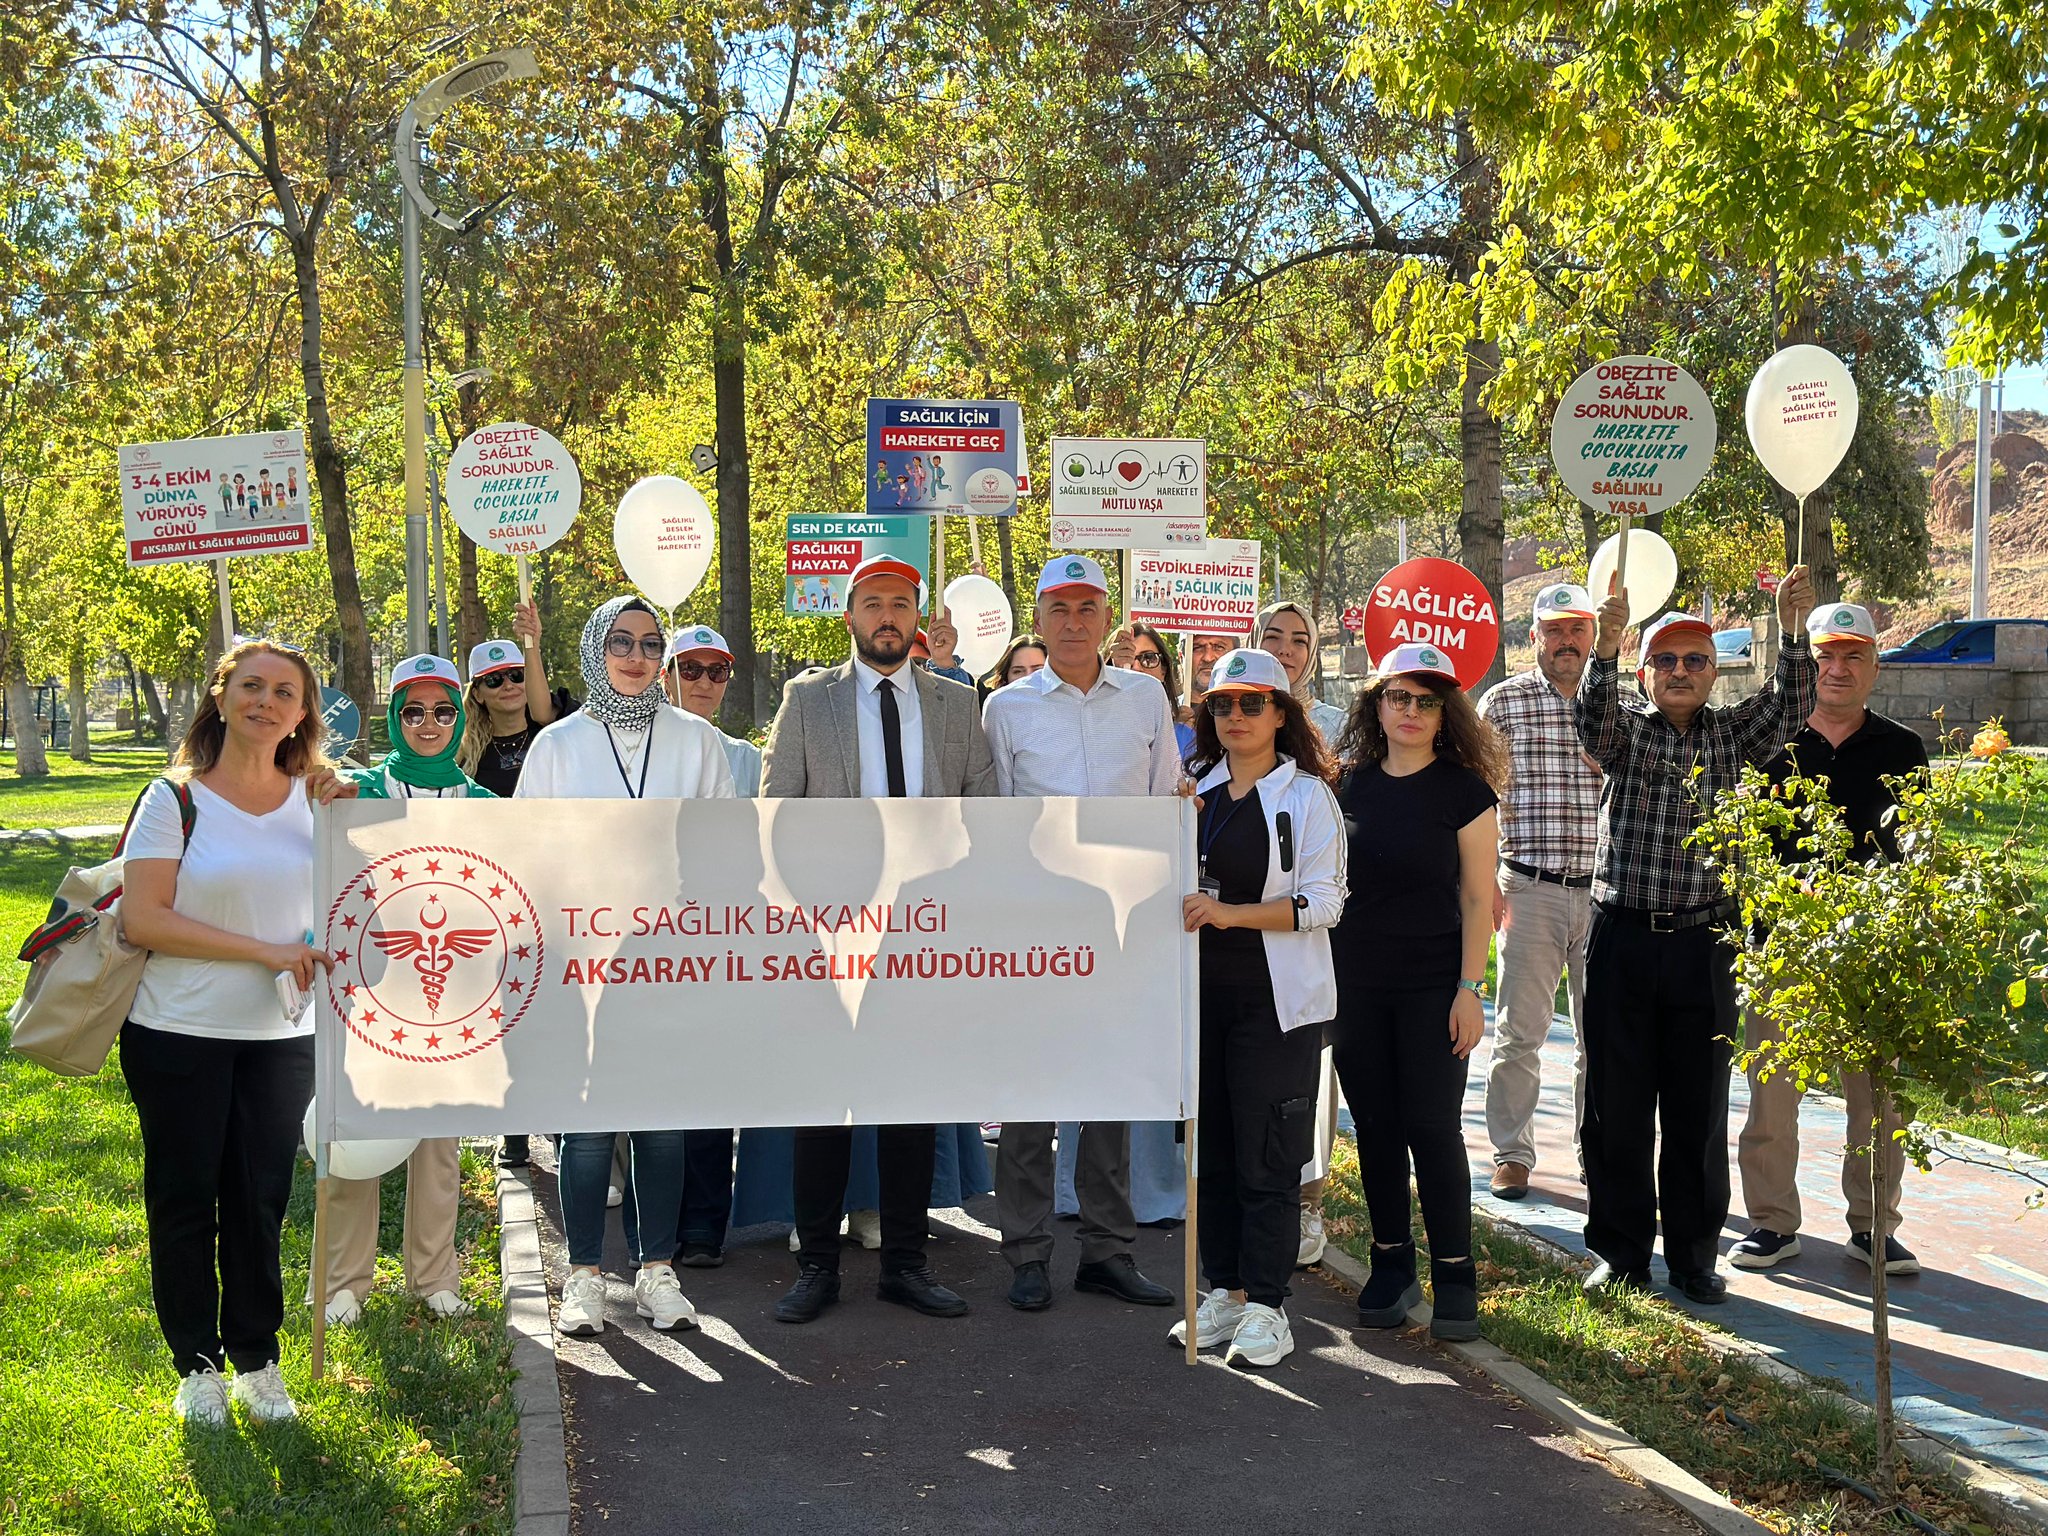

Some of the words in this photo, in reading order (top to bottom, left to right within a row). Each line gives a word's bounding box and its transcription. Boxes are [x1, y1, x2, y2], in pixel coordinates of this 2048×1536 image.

[1596, 364, 1678, 382] OBEZİTE
[1598, 381, 1666, 400] SAĞLIK
[1787, 380, 1828, 393] SAĞLIKLI
[1791, 391, 1825, 402] BESLEN
[1573, 403, 1694, 421] SORUNUDUR.
[1782, 402, 1816, 414] SAĞLIK
[1818, 400, 1837, 410] İÇİN
[899, 409, 955, 424] SAĞLIK
[958, 410, 990, 427] İÇİN
[1783, 411, 1825, 425] HAREKET
[1828, 410, 1838, 418] ET
[473, 428, 540, 446] OBEZİTE
[1592, 423, 1680, 441] HAREKETE
[885, 434, 966, 448] HAREKETE
[969, 435, 1000, 451] GEÇ
[1580, 442, 1689, 460] ÇOCUKLUKTA
[478, 444, 533, 461] SAĞLIK
[461, 459, 559, 478] SORUNUDUR.
[1606, 462, 1659, 479] BAŞLA
[131, 473, 161, 490] 3-4
[166, 467, 211, 487] EKİM
[481, 475, 549, 493] HAREKETE
[1091, 486, 1118, 496] BESLEN
[1157, 487, 1188, 496] HAREKET
[1190, 487, 1198, 496] ET
[1592, 479, 1663, 496] SAĞLIKLI
[144, 488, 197, 505] DÜNYA
[473, 490, 559, 511] ÇOCUKLUKTA
[136, 503, 207, 522] YÜRÜYÜŞ
[1102, 498, 1137, 511] MUTLU
[1138, 498, 1163, 513] YAŞA
[1608, 500, 1648, 517] YAŞA
[498, 507, 539, 524] BAŞLA
[661, 516, 695, 524] SAĞLIKLI
[153, 522, 197, 538] GÜNÜ
[488, 523, 547, 539] SAĞLIKLI
[792, 523, 820, 534] SEN
[823, 523, 844, 534] DE
[847, 522, 888, 534] KATIL
[142, 541, 186, 555] AKSARAY
[188, 540, 198, 551] İL
[199, 536, 235, 550] SAĞLIK
[236, 530, 299, 547] MÜDÜRLÜĞÜ
[657, 534, 685, 542] SAĞLIK
[687, 533, 701, 541] İÇİN
[505, 541, 538, 554] YAŞA
[657, 543, 692, 551] HAREKET
[791, 541, 856, 555] SAĞLIKLI
[791, 559, 849, 570] HAYATA
[1140, 559, 1254, 578] SEVDİKLERİMİZLE
[1175, 578, 1223, 595] SAĞLIK
[1226, 580, 1253, 599] İÇİN
[1173, 595, 1254, 614] YÜRÜYORUZ
[1375, 585, 1496, 625] SAĞLIĞA
[1137, 616, 1169, 626] AKSARAY
[1170, 616, 1177, 625] İL
[1178, 616, 1203, 627] SAĞLIK
[1203, 618, 1248, 629] MÜDÜRLÜĞÜ
[1390, 618, 1466, 650] ADIM
[561, 907, 621, 937] T.C.
[632, 899, 755, 937] SAĞLIK
[766, 897, 947, 935] BAKANLIĞI
[562, 955, 717, 985] AKSARAY
[726, 950, 753, 982] İL
[762, 948, 878, 982] SAĞLIK
[886, 945, 1095, 980] MÜDÜRLÜĞÜ
